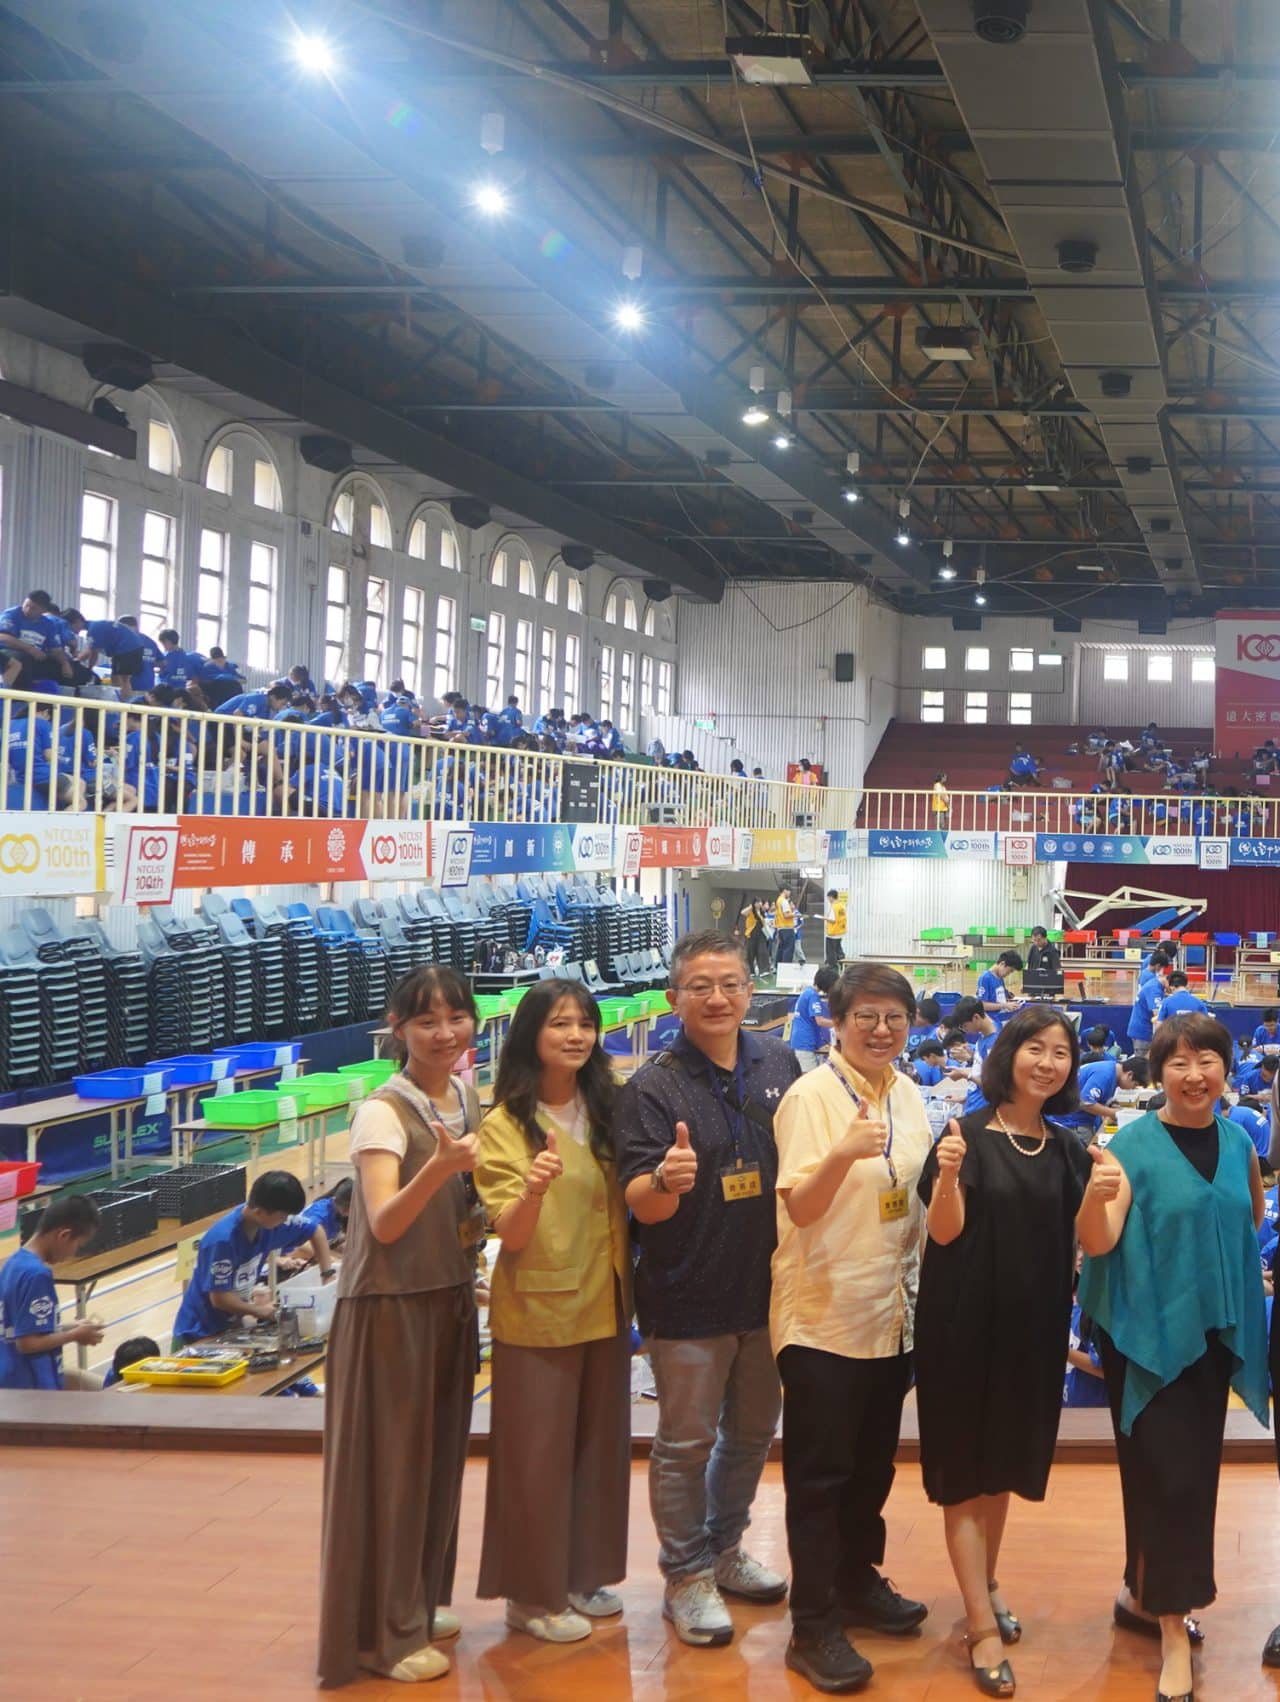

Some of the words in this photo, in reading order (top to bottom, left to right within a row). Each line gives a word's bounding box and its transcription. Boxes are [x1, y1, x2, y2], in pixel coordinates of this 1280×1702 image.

[45, 846, 90, 868] 100th
[399, 843, 423, 860] 100th
[136, 876, 164, 890] 100th
